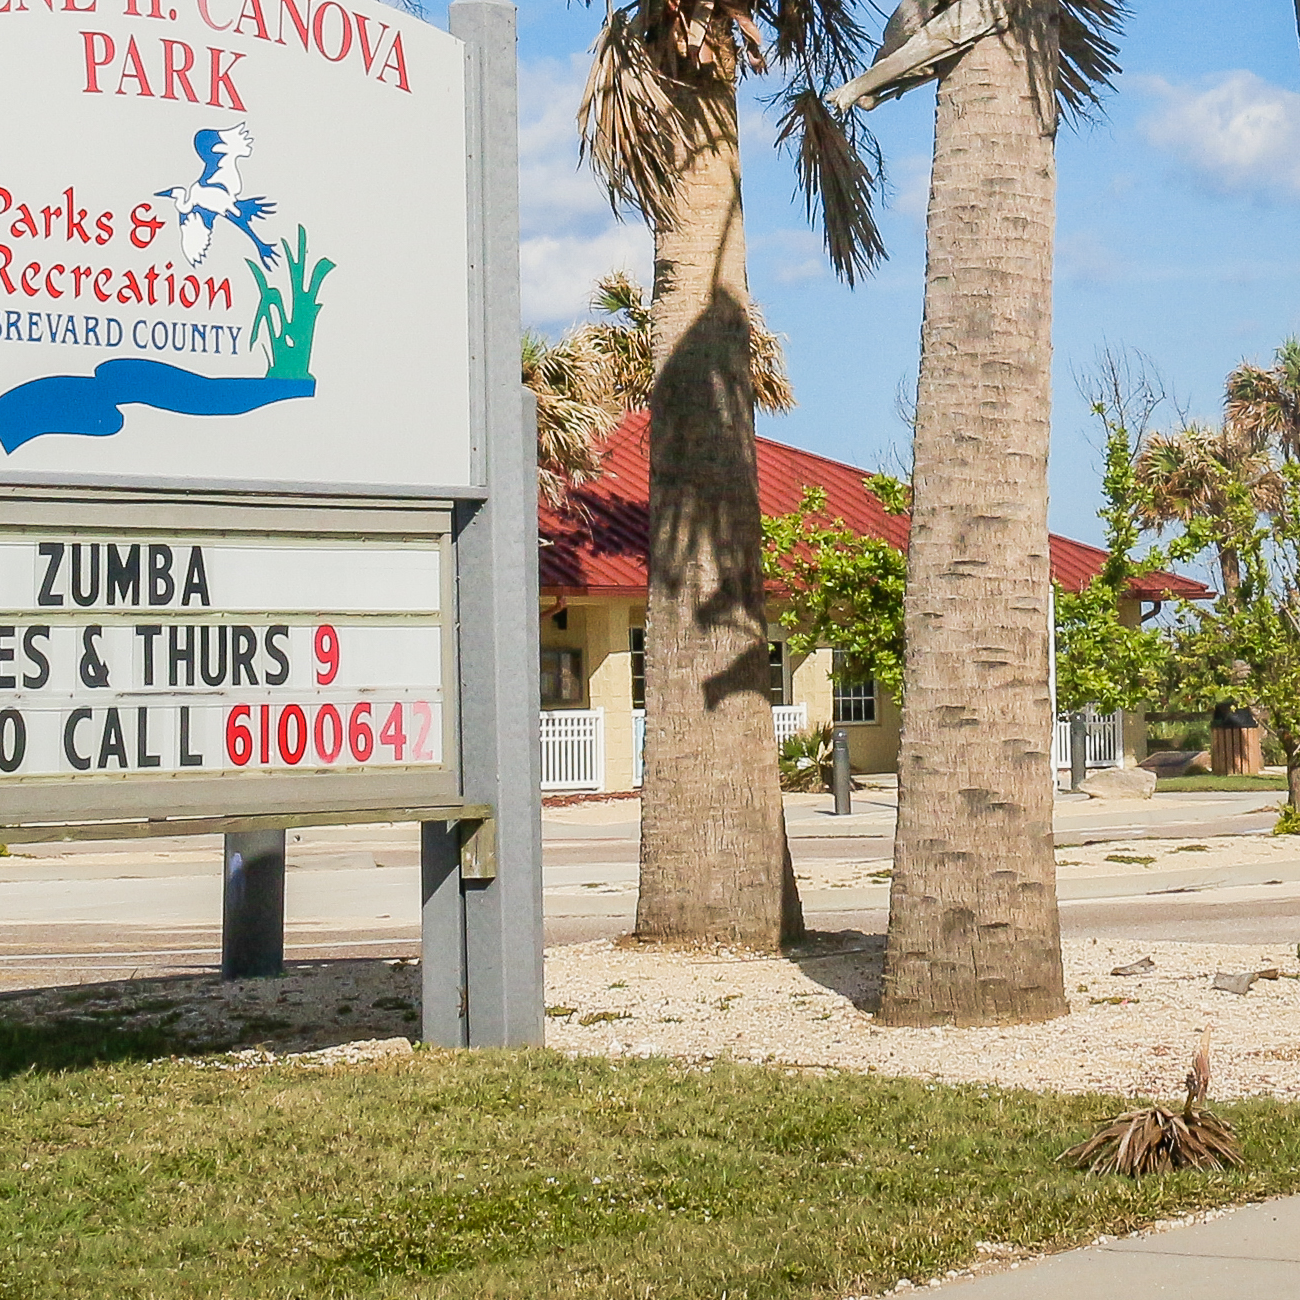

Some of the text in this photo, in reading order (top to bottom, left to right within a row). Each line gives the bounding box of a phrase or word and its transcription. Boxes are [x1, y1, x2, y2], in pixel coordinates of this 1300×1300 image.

[79, 31, 248, 112] PARK
[130, 203, 166, 248] &
[133, 319, 243, 354] COUNTY
[38, 542, 211, 606] ZUMBA
[79, 625, 109, 688] &
[136, 625, 290, 686] THURS
[314, 624, 340, 686] 9
[64, 705, 202, 770] CALL
[226, 701, 433, 766] 6100642
